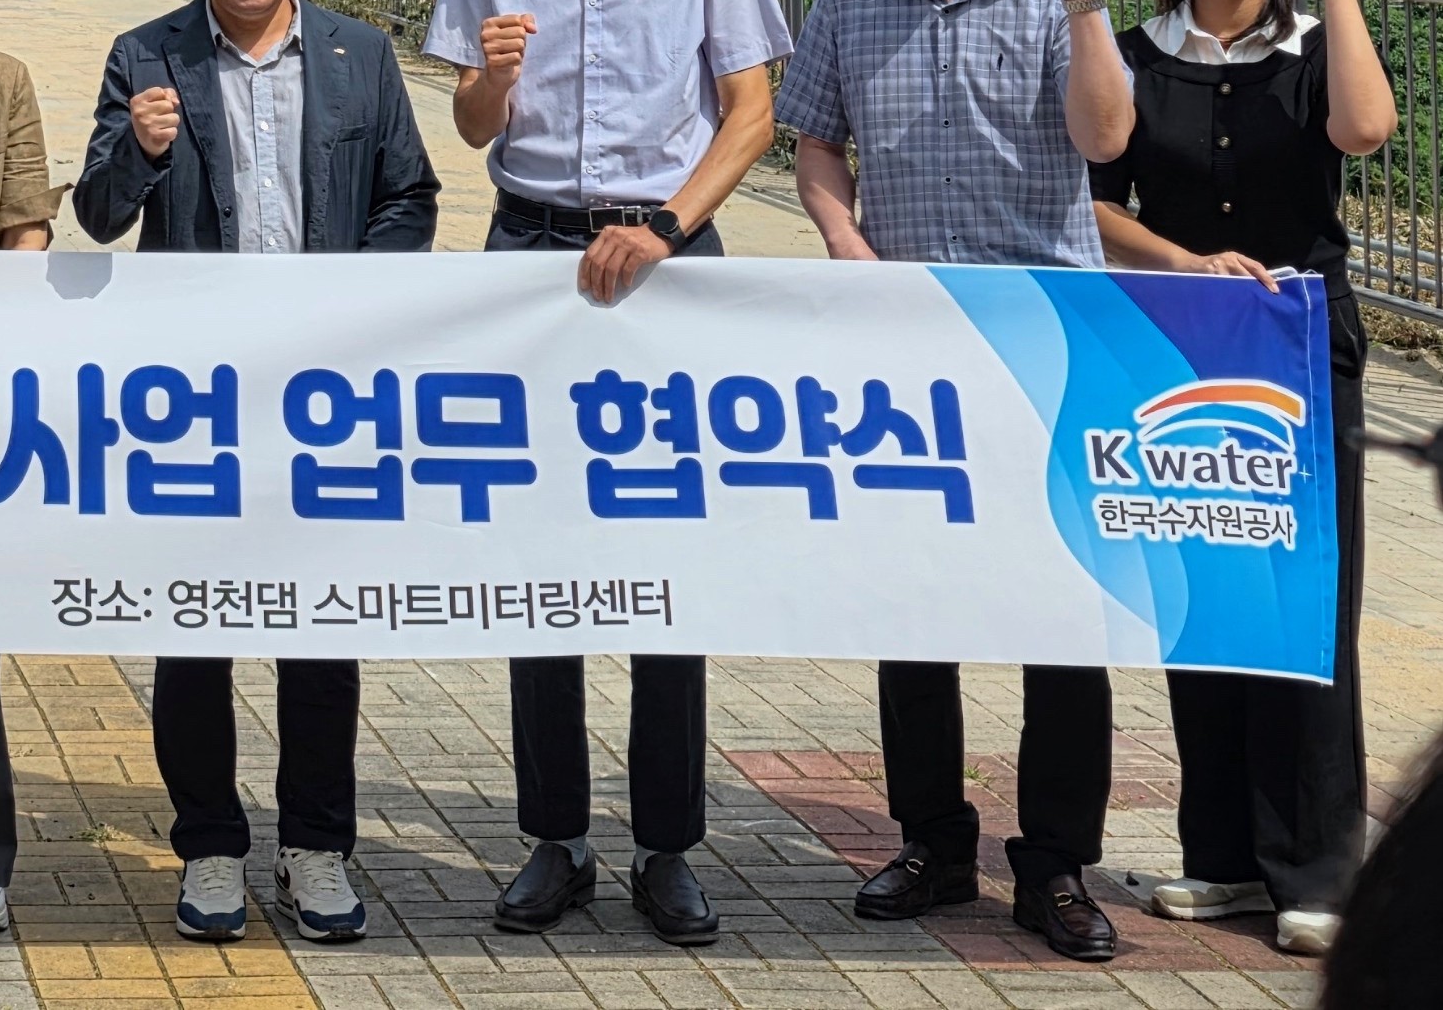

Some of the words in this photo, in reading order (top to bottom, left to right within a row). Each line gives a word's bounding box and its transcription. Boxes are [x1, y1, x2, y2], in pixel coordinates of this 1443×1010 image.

[283, 369, 537, 522] 업무
[570, 370, 974, 523] 협약식
[1092, 436, 1131, 478] K
[1146, 445, 1291, 488] water
[1099, 500, 1292, 543] 한국수자원공사
[52, 578, 151, 626] 장소:
[168, 580, 297, 628] 영천댐
[312, 580, 672, 630] 스마트미터링센터
